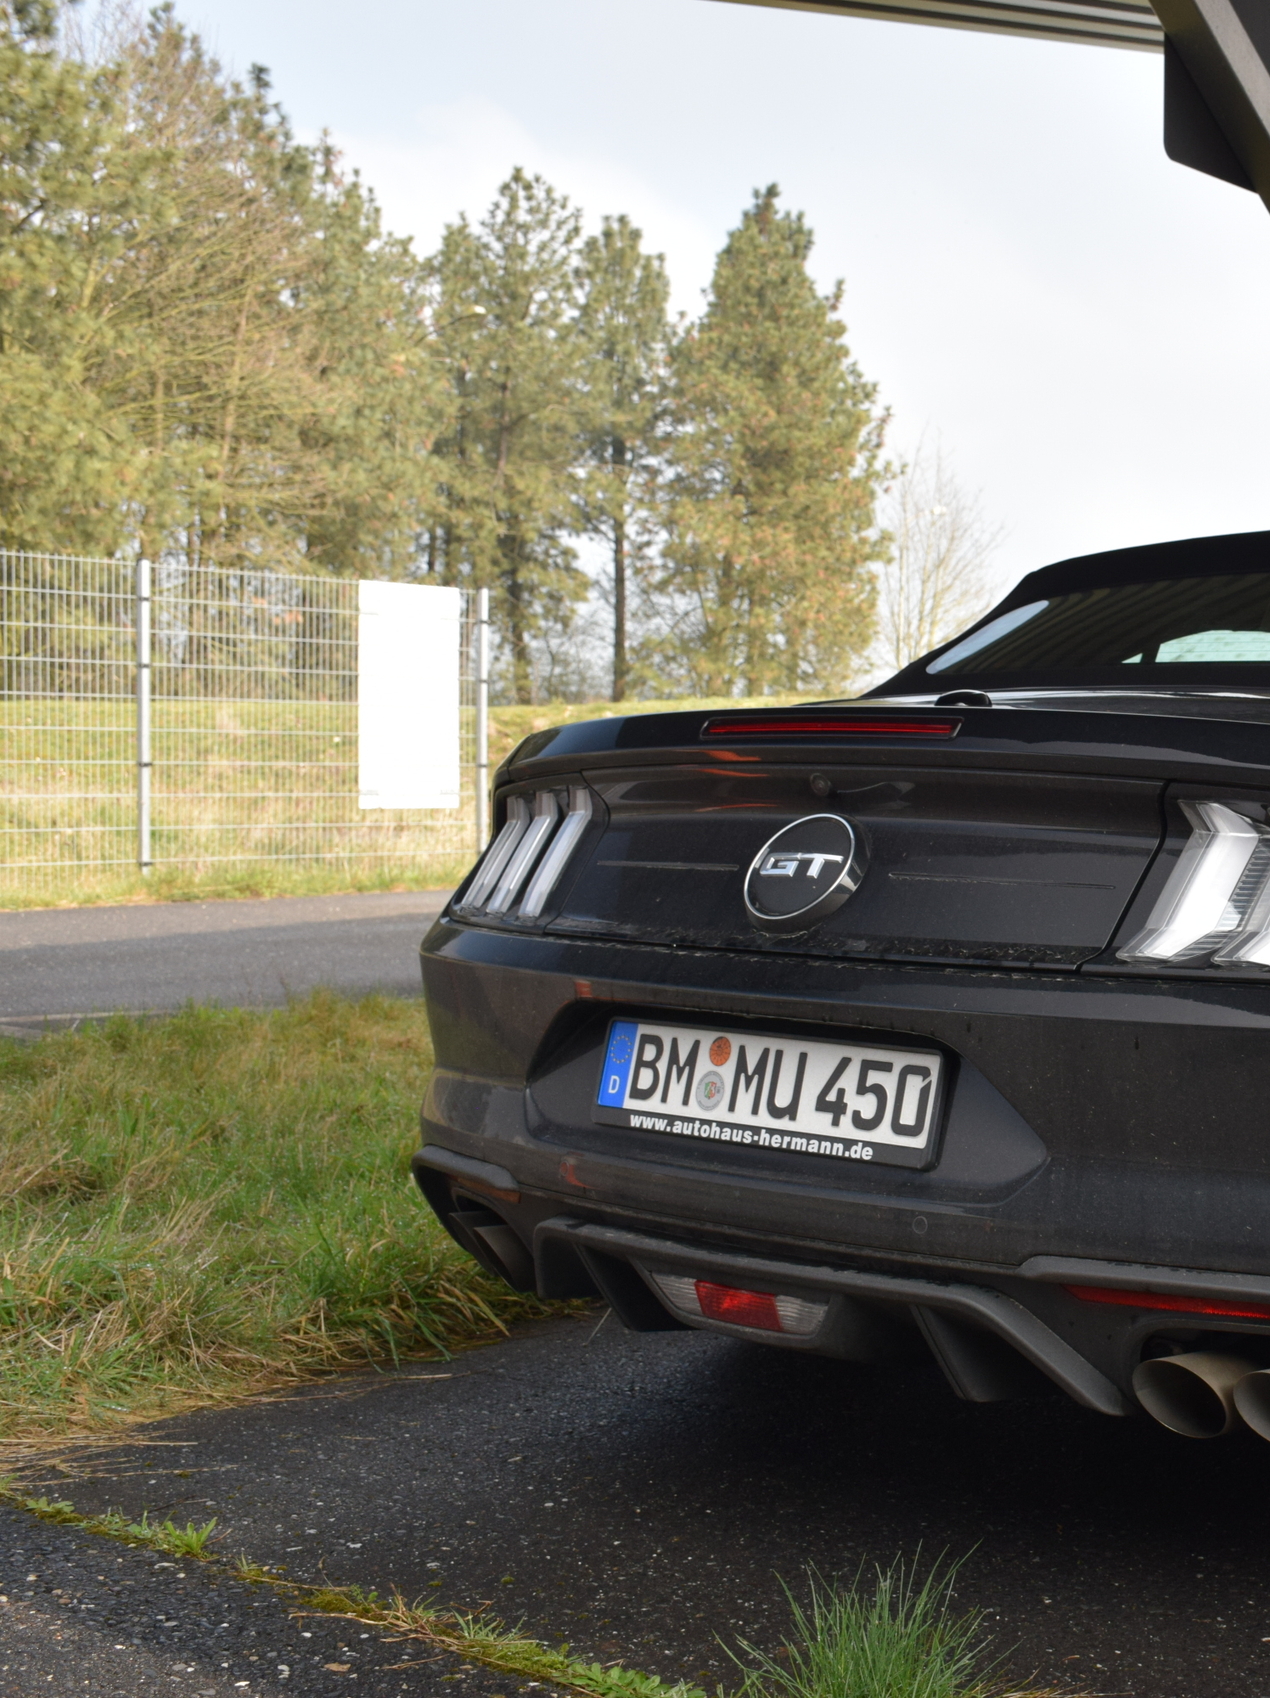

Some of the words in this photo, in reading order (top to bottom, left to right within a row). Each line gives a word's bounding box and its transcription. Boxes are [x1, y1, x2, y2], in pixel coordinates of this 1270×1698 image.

[760, 852, 844, 879] GT
[607, 1074, 621, 1095] D
[628, 1033, 701, 1107] BM
[727, 1044, 809, 1122] MU
[814, 1056, 933, 1138] 450
[629, 1113, 874, 1161] www.autohaus-hermann.de
